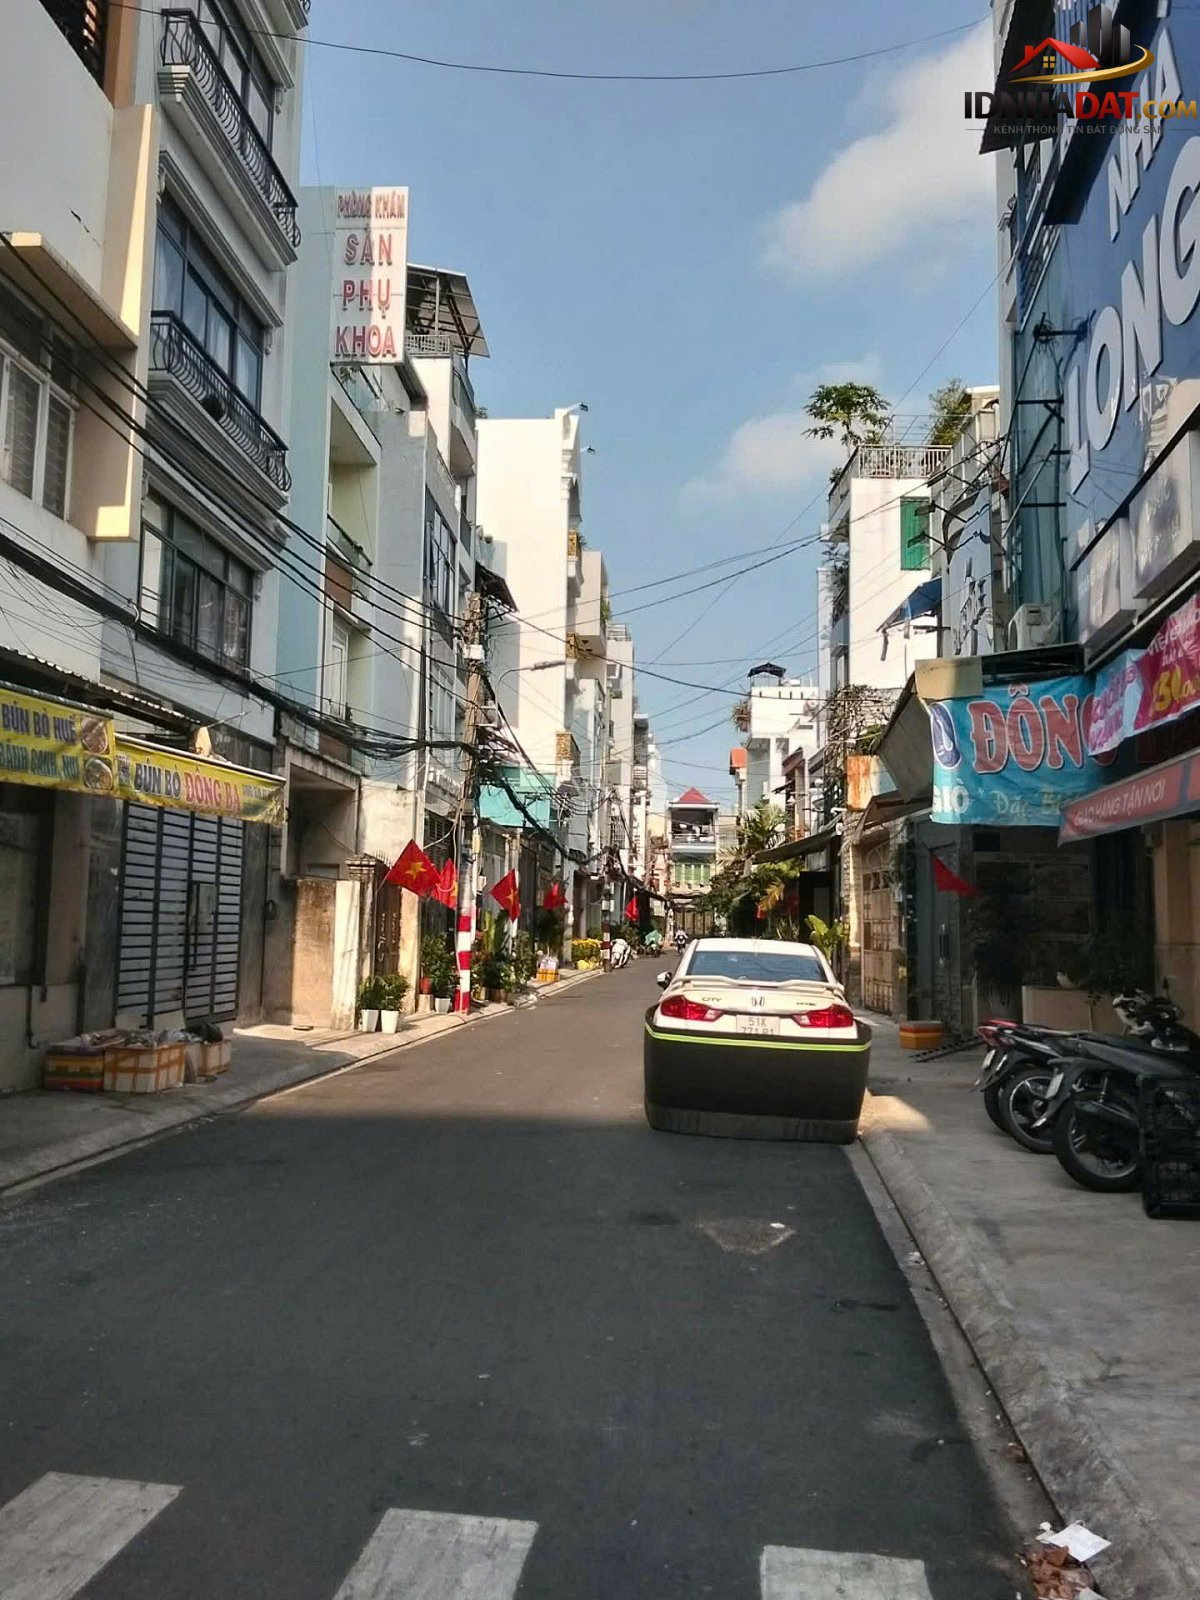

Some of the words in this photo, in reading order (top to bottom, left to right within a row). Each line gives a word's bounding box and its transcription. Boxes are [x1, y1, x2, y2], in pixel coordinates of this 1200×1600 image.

[337, 190, 372, 219] PHÒNG
[374, 189, 406, 219] KHÁM
[344, 223, 393, 266] SẢN
[342, 279, 391, 319] PHỤ
[335, 325, 397, 358] KHOA
[1, 700, 30, 736] BÚN
[33, 707, 50, 739] BÒ
[134, 757, 162, 796] BÚN
[164, 763, 182, 800] BÒ
[184, 765, 222, 808] ĐÔNG
[224, 779, 241, 813] BA
